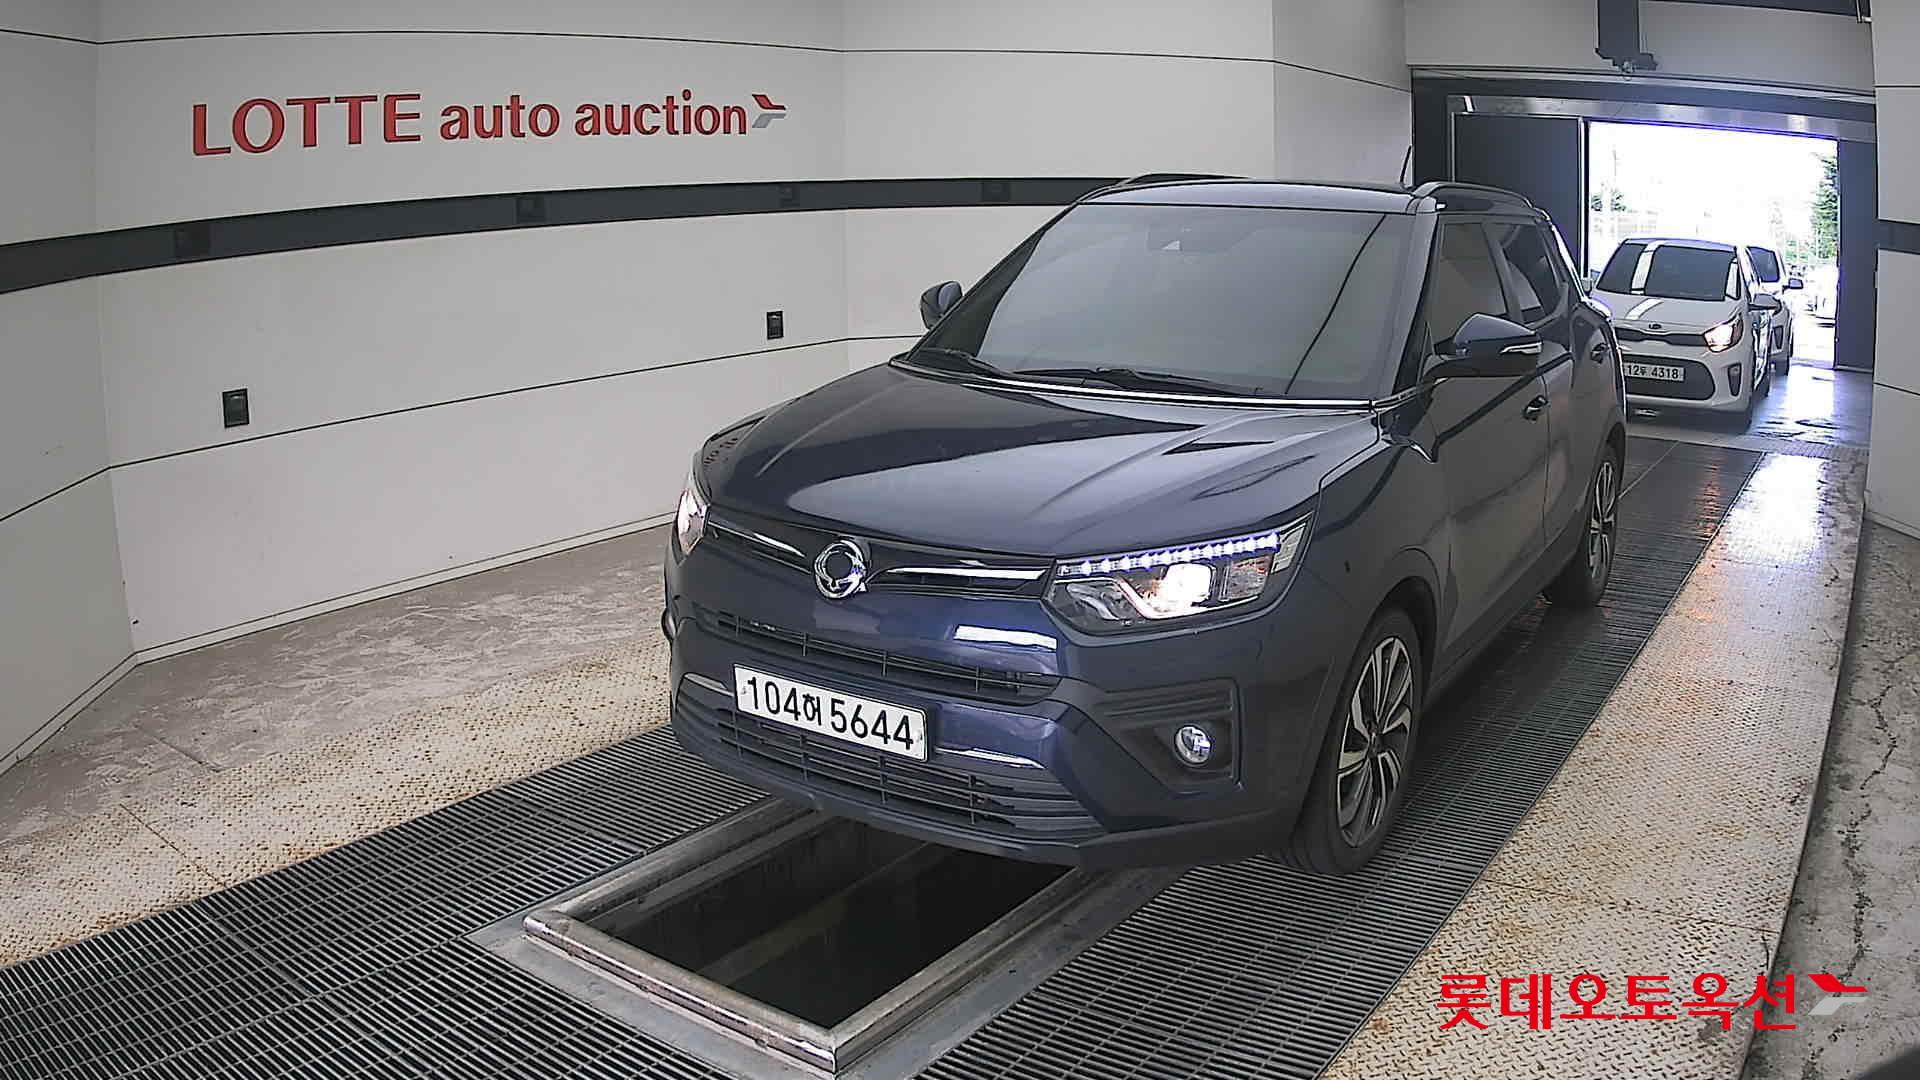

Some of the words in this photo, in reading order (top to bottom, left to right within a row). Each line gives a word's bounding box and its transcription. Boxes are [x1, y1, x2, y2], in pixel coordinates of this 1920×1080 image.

[193, 93, 421, 156] LOTTE
[440, 94, 560, 140] auto
[574, 89, 748, 135] auction
[1651, 367, 1679, 379] 4318
[747, 676, 822, 726] 104허
[831, 697, 914, 750] 5644
